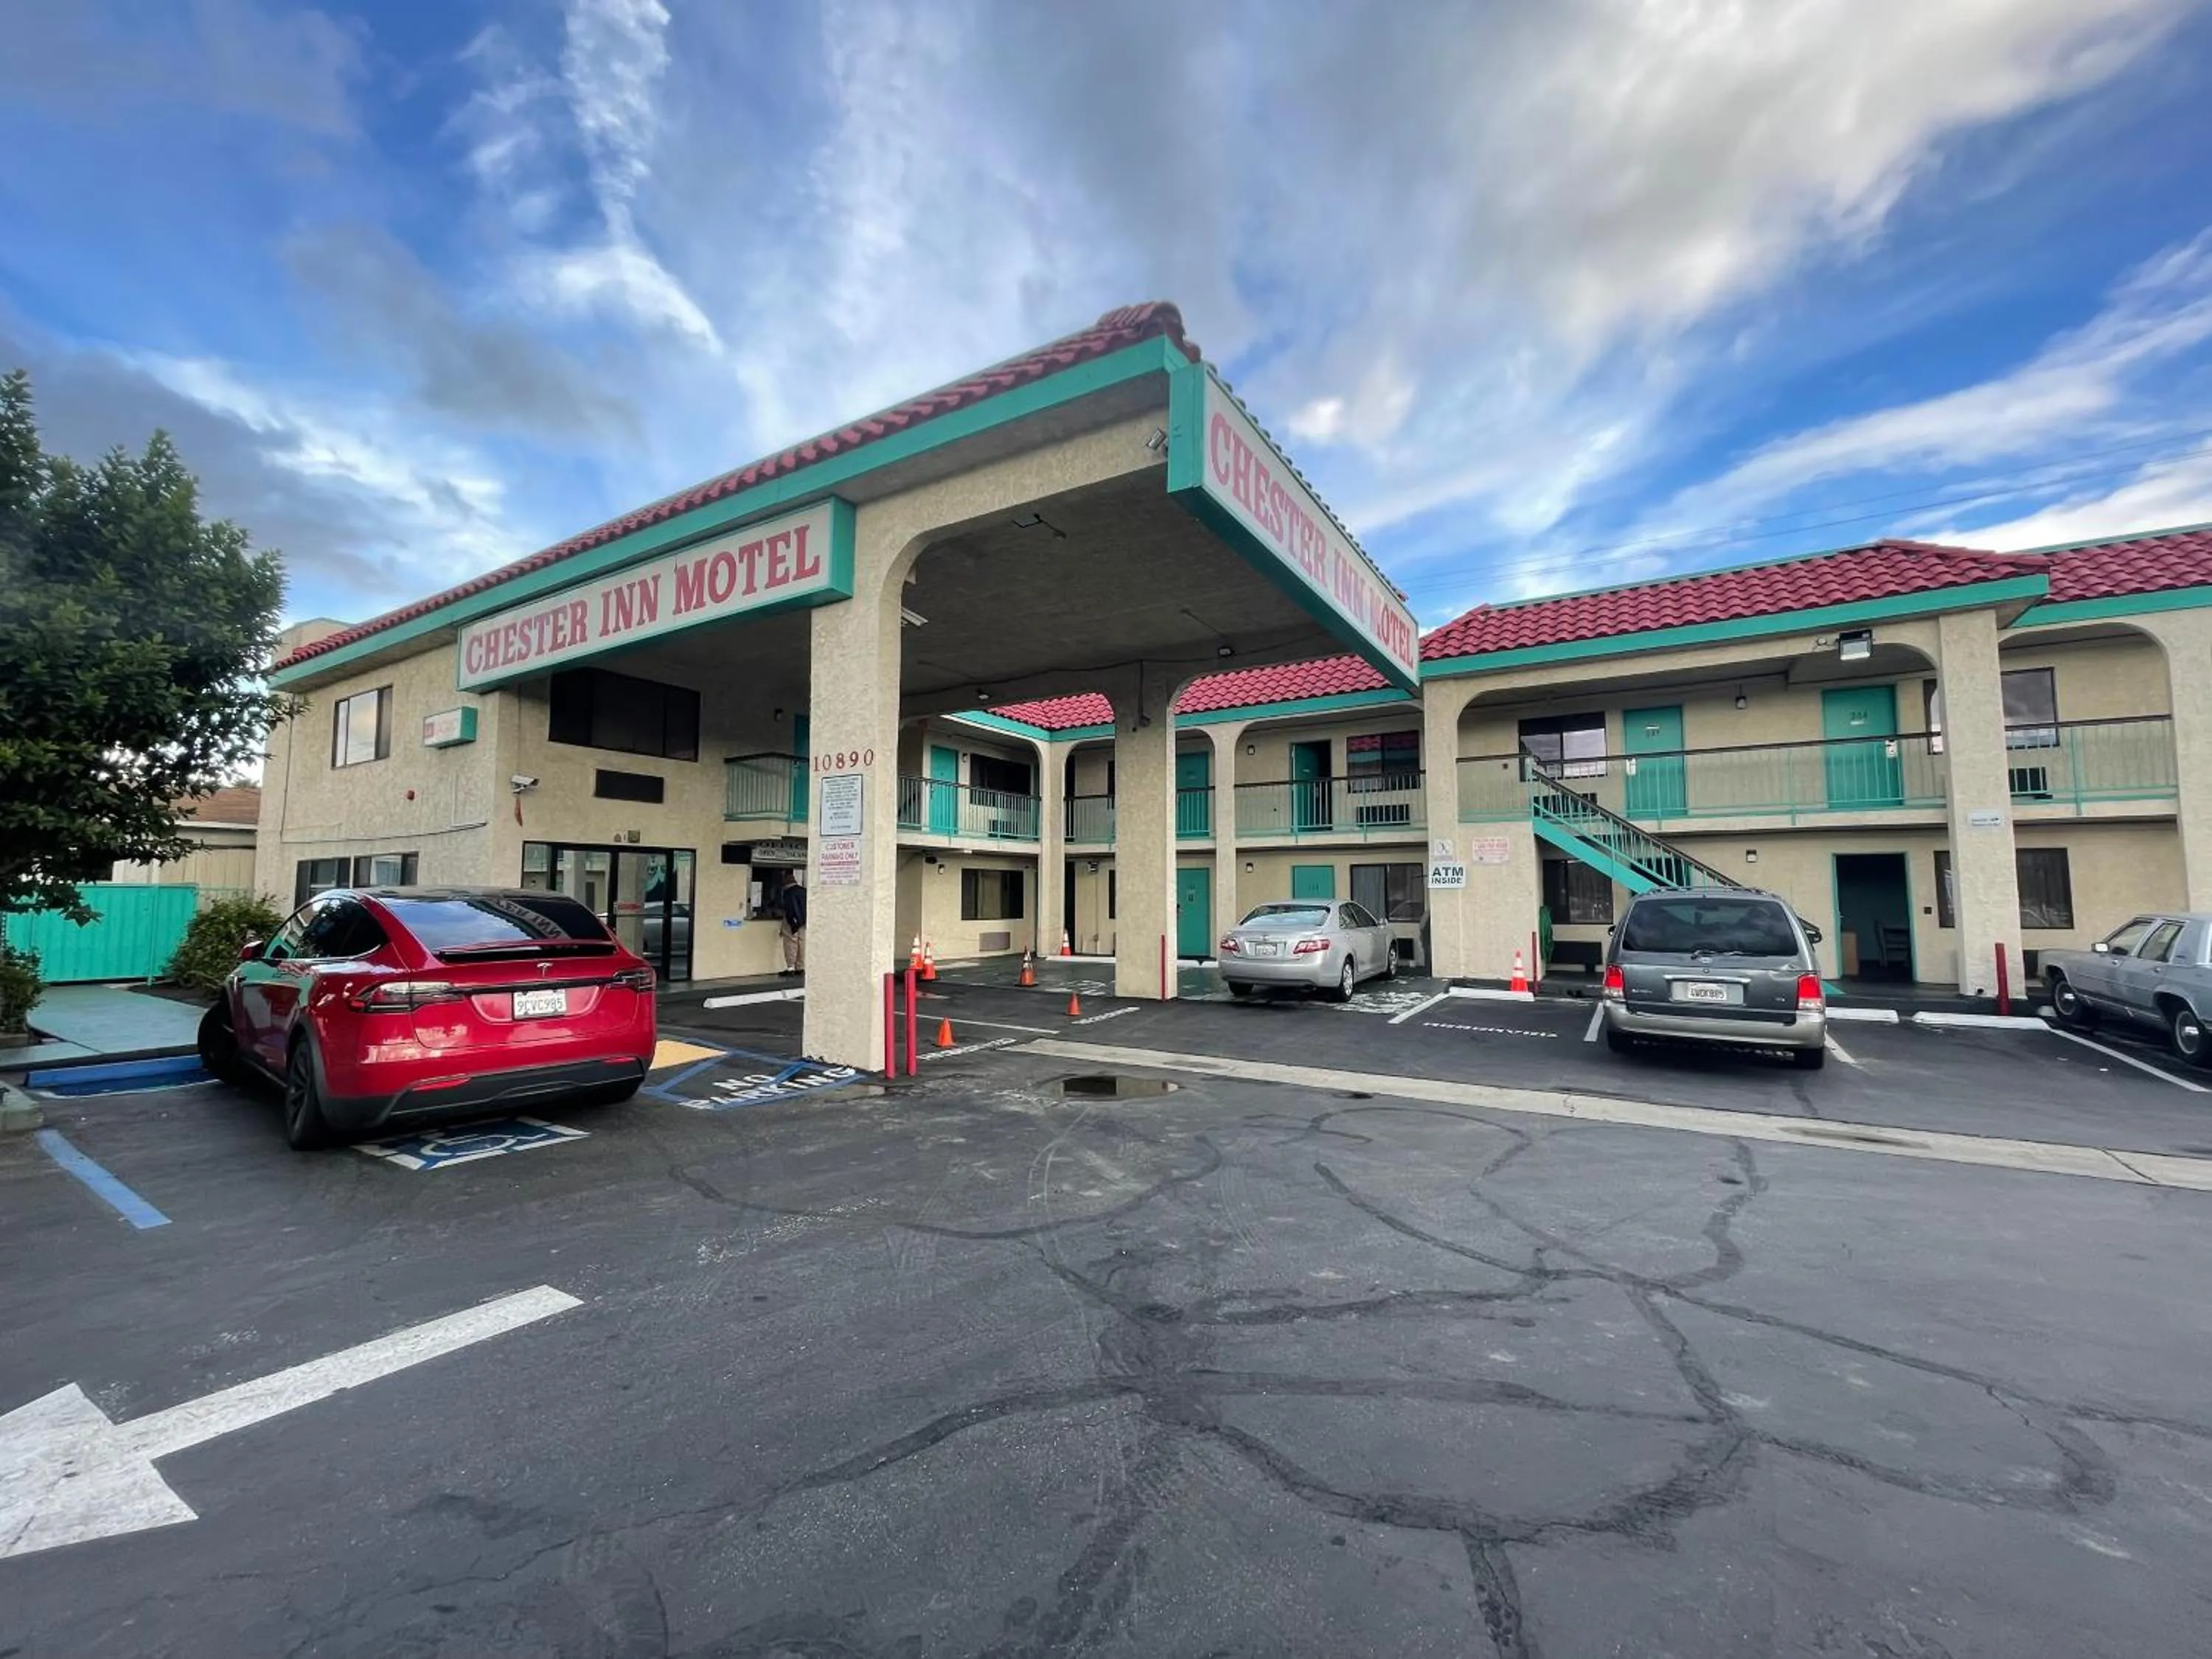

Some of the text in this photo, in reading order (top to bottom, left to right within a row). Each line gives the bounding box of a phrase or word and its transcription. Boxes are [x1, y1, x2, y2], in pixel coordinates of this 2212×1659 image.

[1209, 411, 1413, 669] CHESTER INN MOTEL
[465, 524, 821, 675] CHESTER INN MOTEL
[813, 748, 874, 772] 10890
[1432, 866, 1464, 877] ATM
[678, 1067, 856, 1110] PARKING
[712, 1074, 775, 1091] NO
